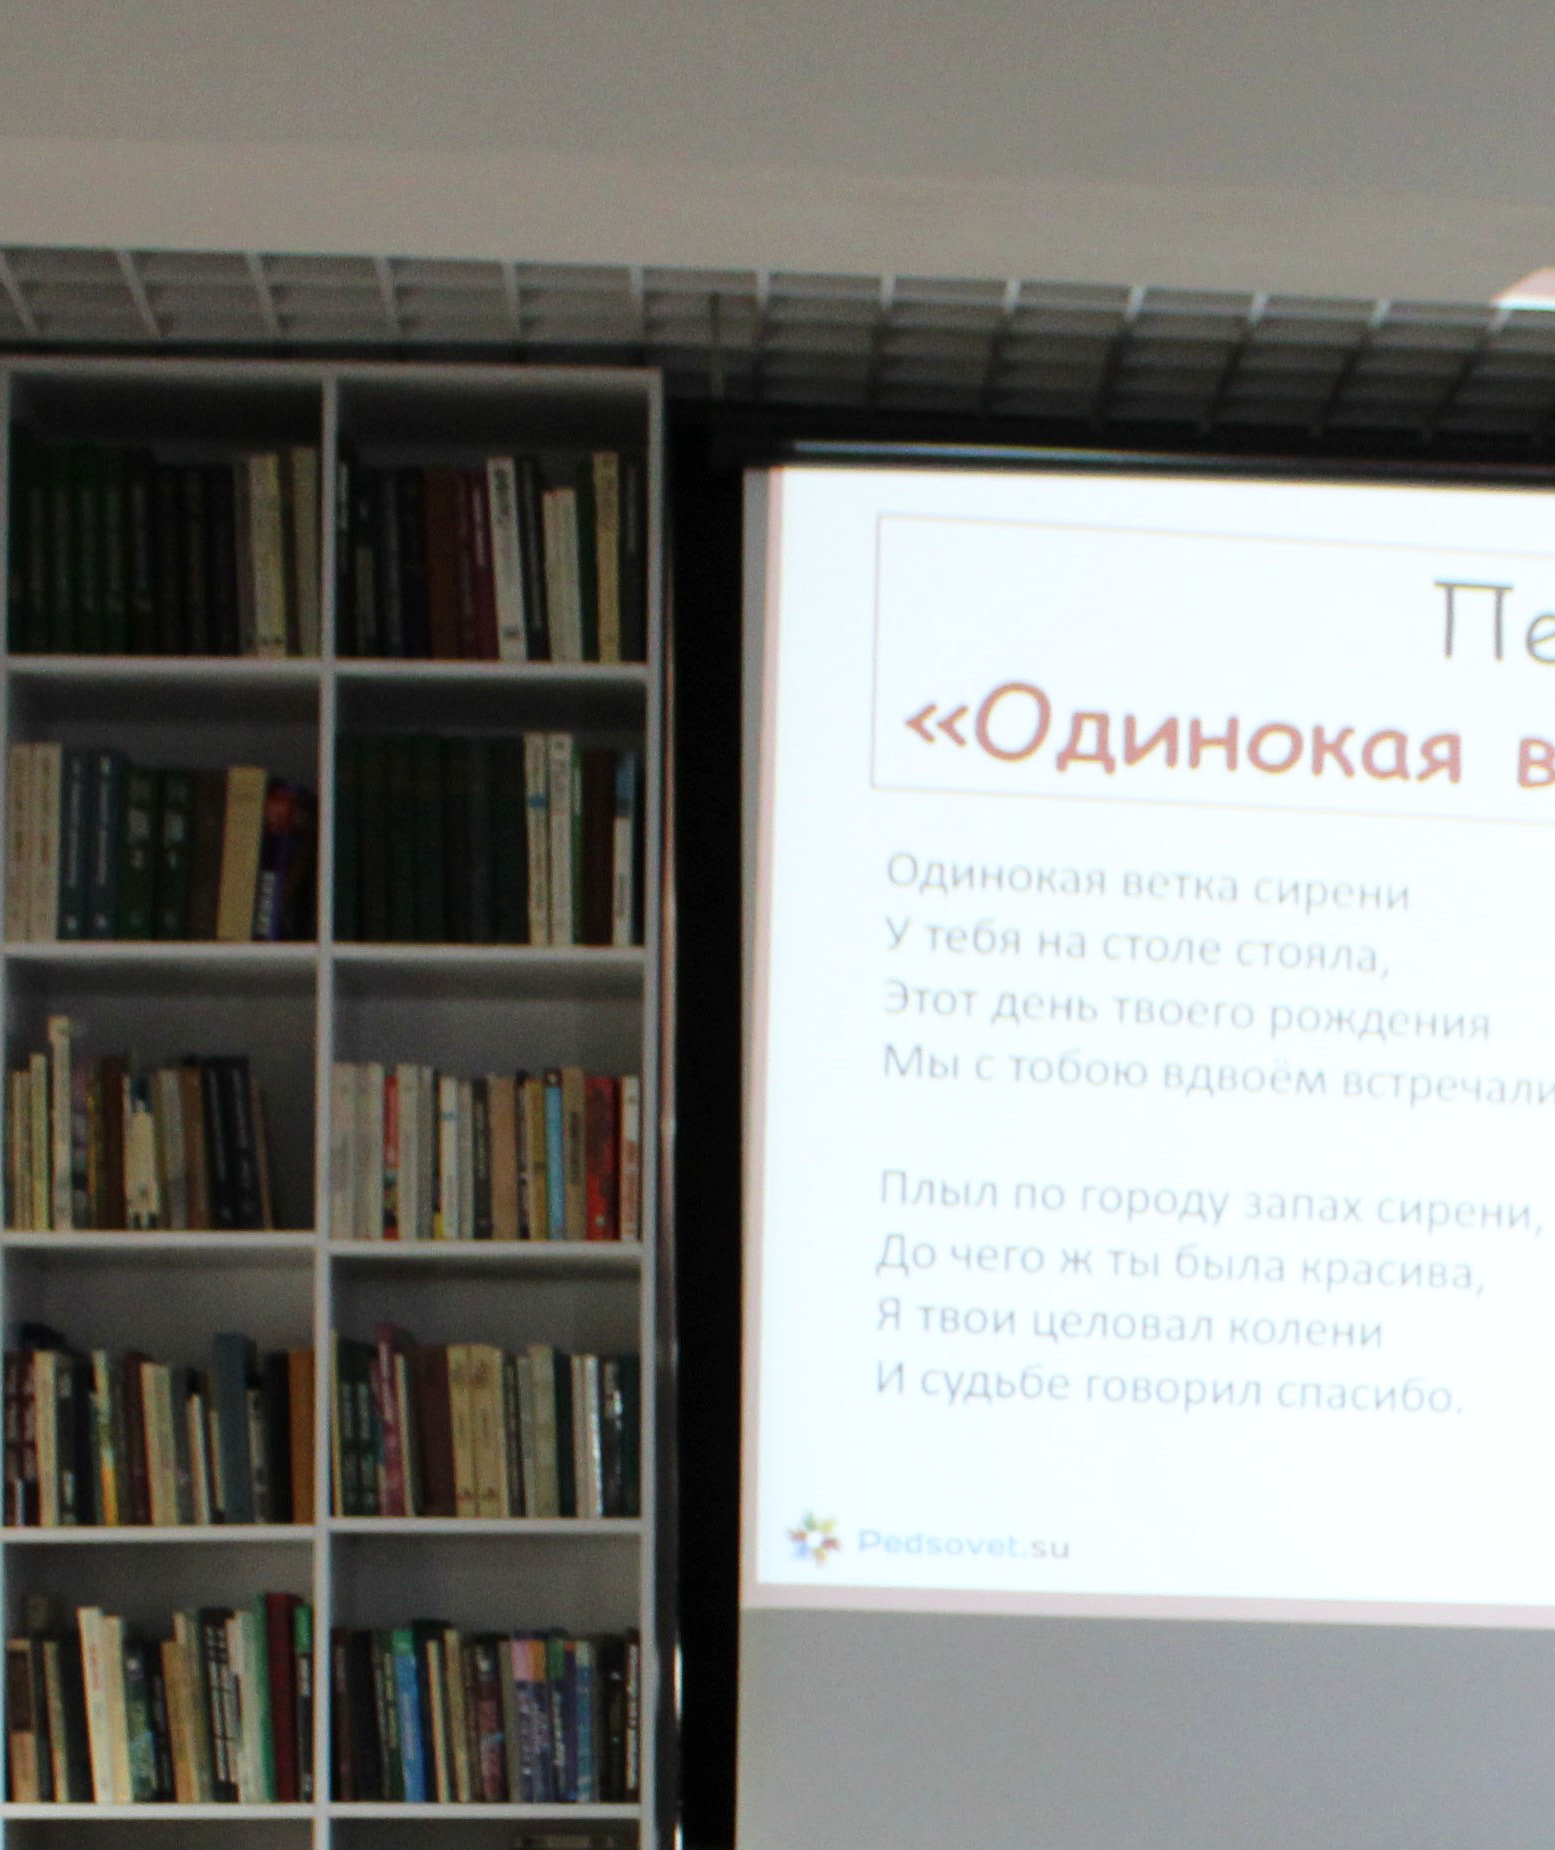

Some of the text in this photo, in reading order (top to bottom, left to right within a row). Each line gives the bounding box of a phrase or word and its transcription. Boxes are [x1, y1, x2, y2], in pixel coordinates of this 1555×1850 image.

[905, 681, 1461, 785] «Одинокая
[886, 850, 1411, 915] Одинокая ветка сирени
[884, 915, 1390, 979] У тебя на столе стояла,
[886, 977, 1490, 1042] Этот день твоего рождения
[883, 1042, 959, 1079] Мы
[974, 1053, 993, 1081] с
[1009, 1049, 1149, 1086] тобою
[1163, 1062, 1327, 1097] вдвоём
[880, 1168, 1543, 1236] Плыл по городу запах сирени,
[874, 1231, 1485, 1297] До чего ж ты была красива,
[876, 1296, 1383, 1348] Я твои целовал колени
[876, 1360, 1463, 1414] И судьбе говорил спасибо.
[858, 1528, 1069, 1559] Pedsovet.su
